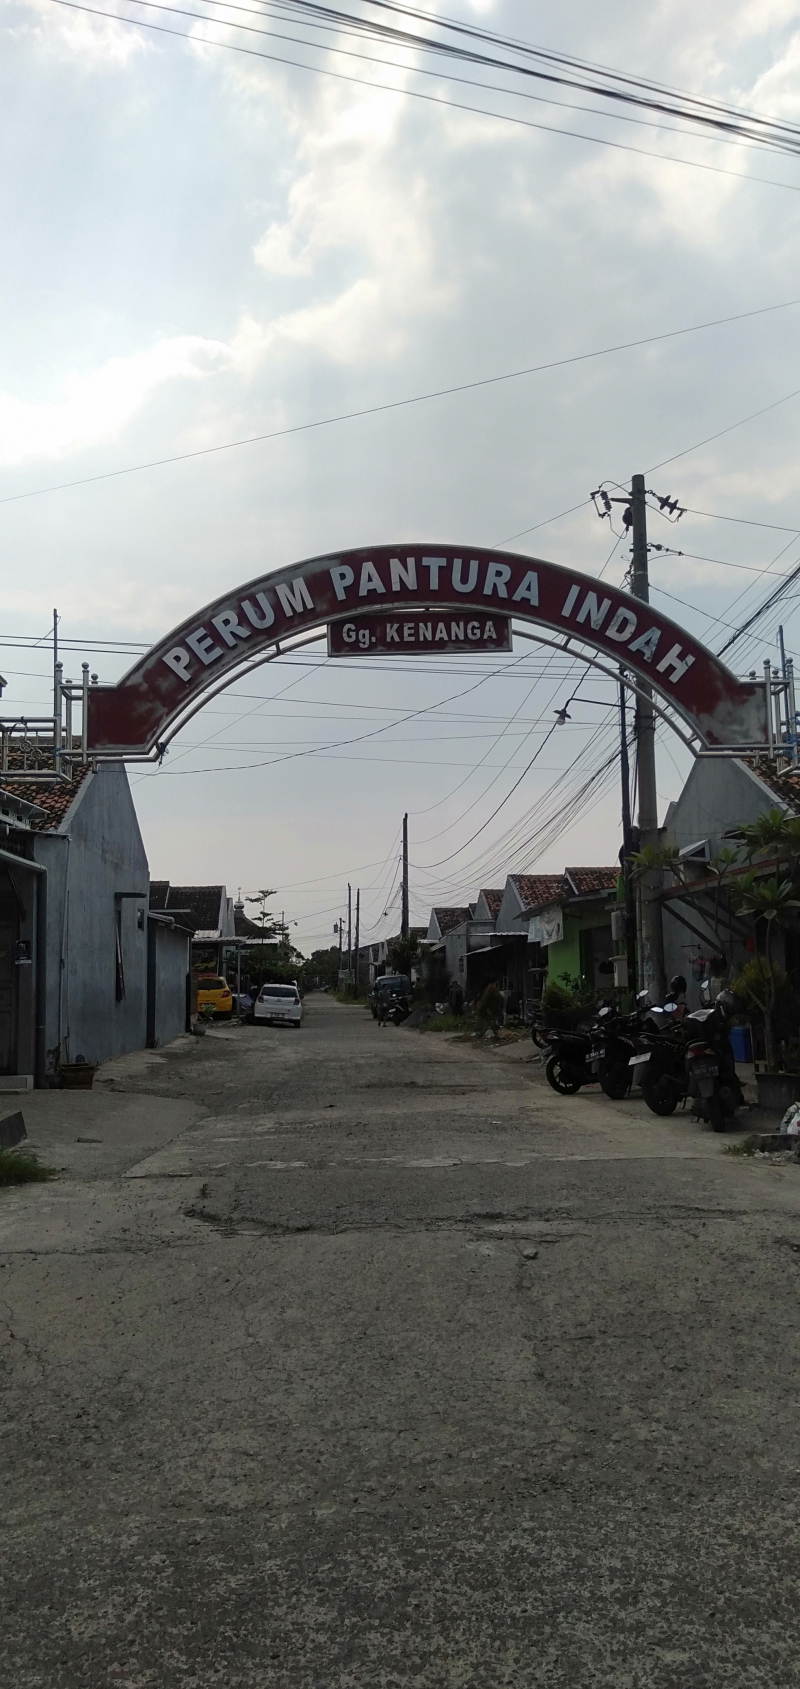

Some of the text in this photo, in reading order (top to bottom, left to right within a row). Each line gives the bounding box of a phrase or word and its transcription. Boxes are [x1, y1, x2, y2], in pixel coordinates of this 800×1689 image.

[162, 556, 696, 684] PERUM PANTURA INDAH
[342, 620, 498, 648] Gg. KENANGA
